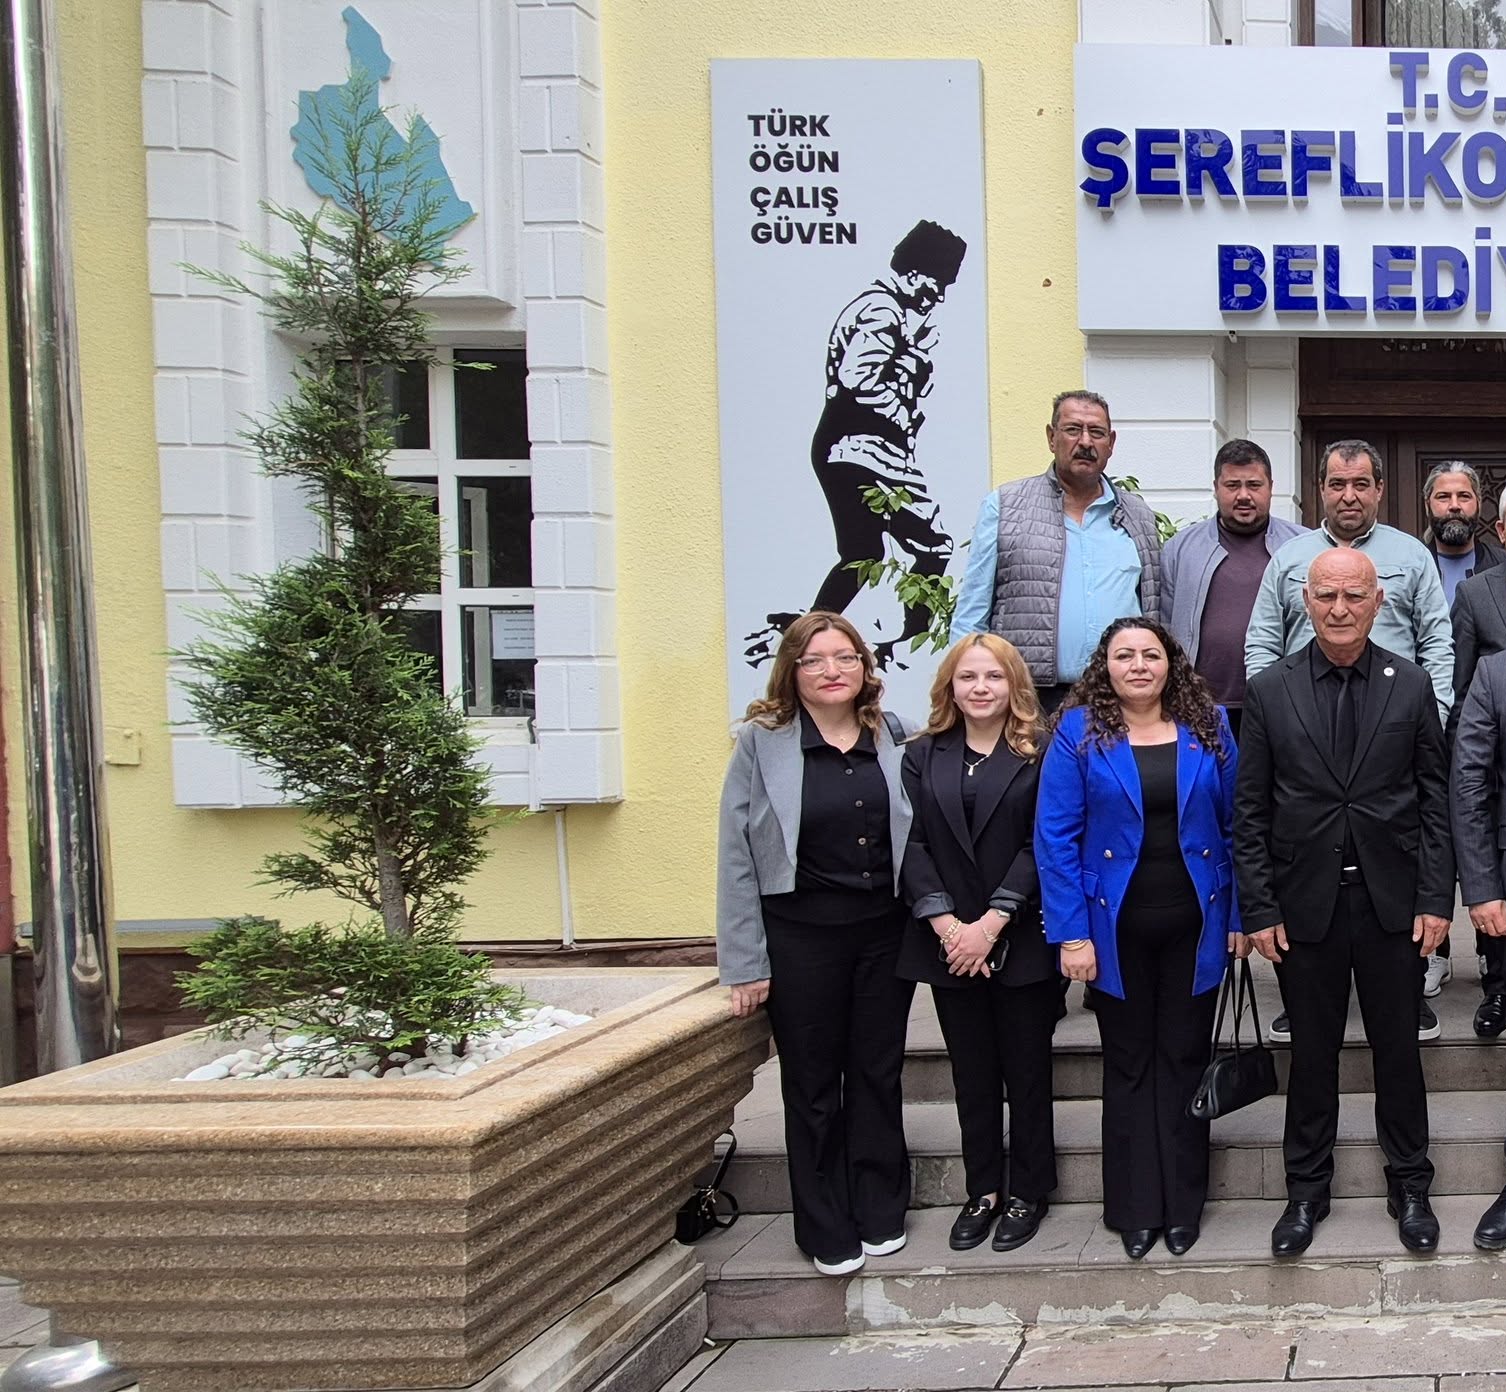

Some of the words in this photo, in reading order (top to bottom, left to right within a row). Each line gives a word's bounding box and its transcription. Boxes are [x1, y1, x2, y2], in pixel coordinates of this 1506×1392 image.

[747, 108, 830, 137] TÜRK
[749, 143, 839, 172] ÖĞÜN
[750, 186, 839, 217] ÇALIŞ
[751, 215, 857, 244] GÜVEN
